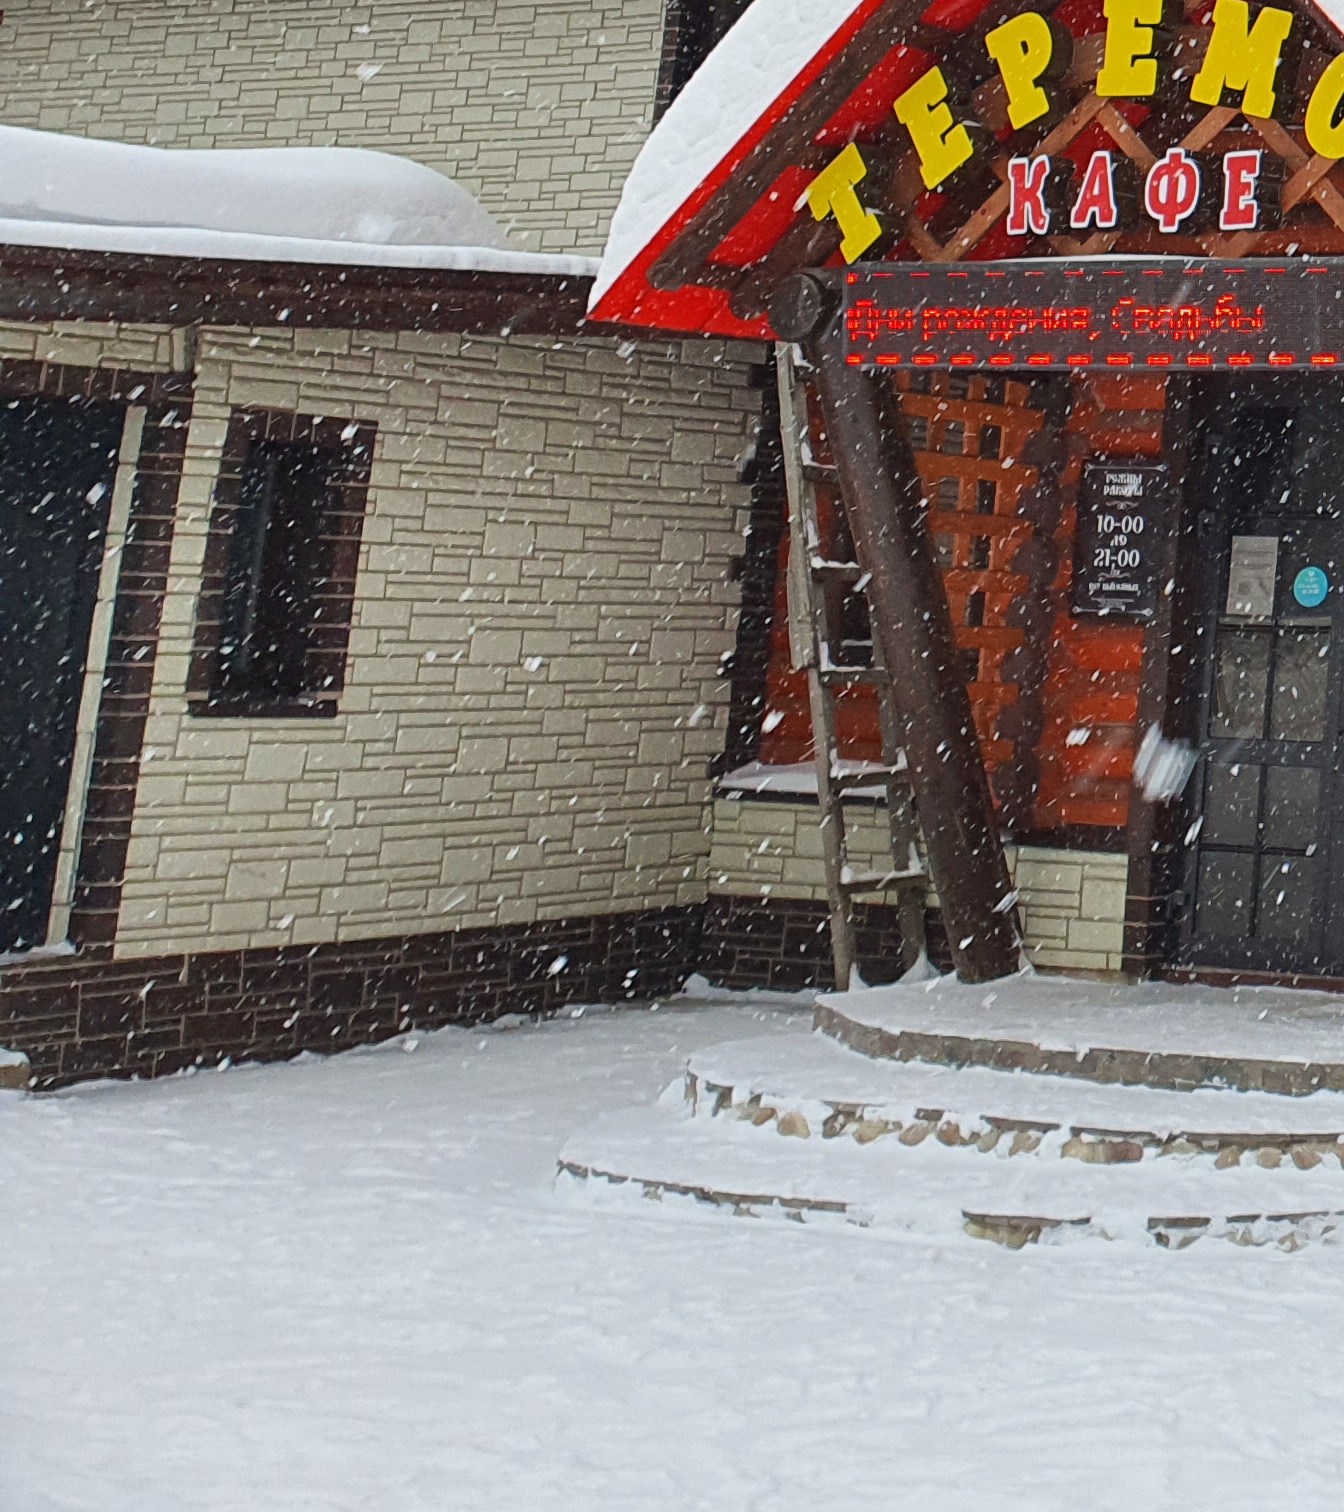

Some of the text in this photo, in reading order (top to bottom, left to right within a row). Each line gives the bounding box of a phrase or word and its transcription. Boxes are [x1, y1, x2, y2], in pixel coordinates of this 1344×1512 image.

[1006, 147, 1263, 236] КАФЕ
[1096, 514, 1145, 534] 10-00
[1093, 548, 1141, 568] 21-00
